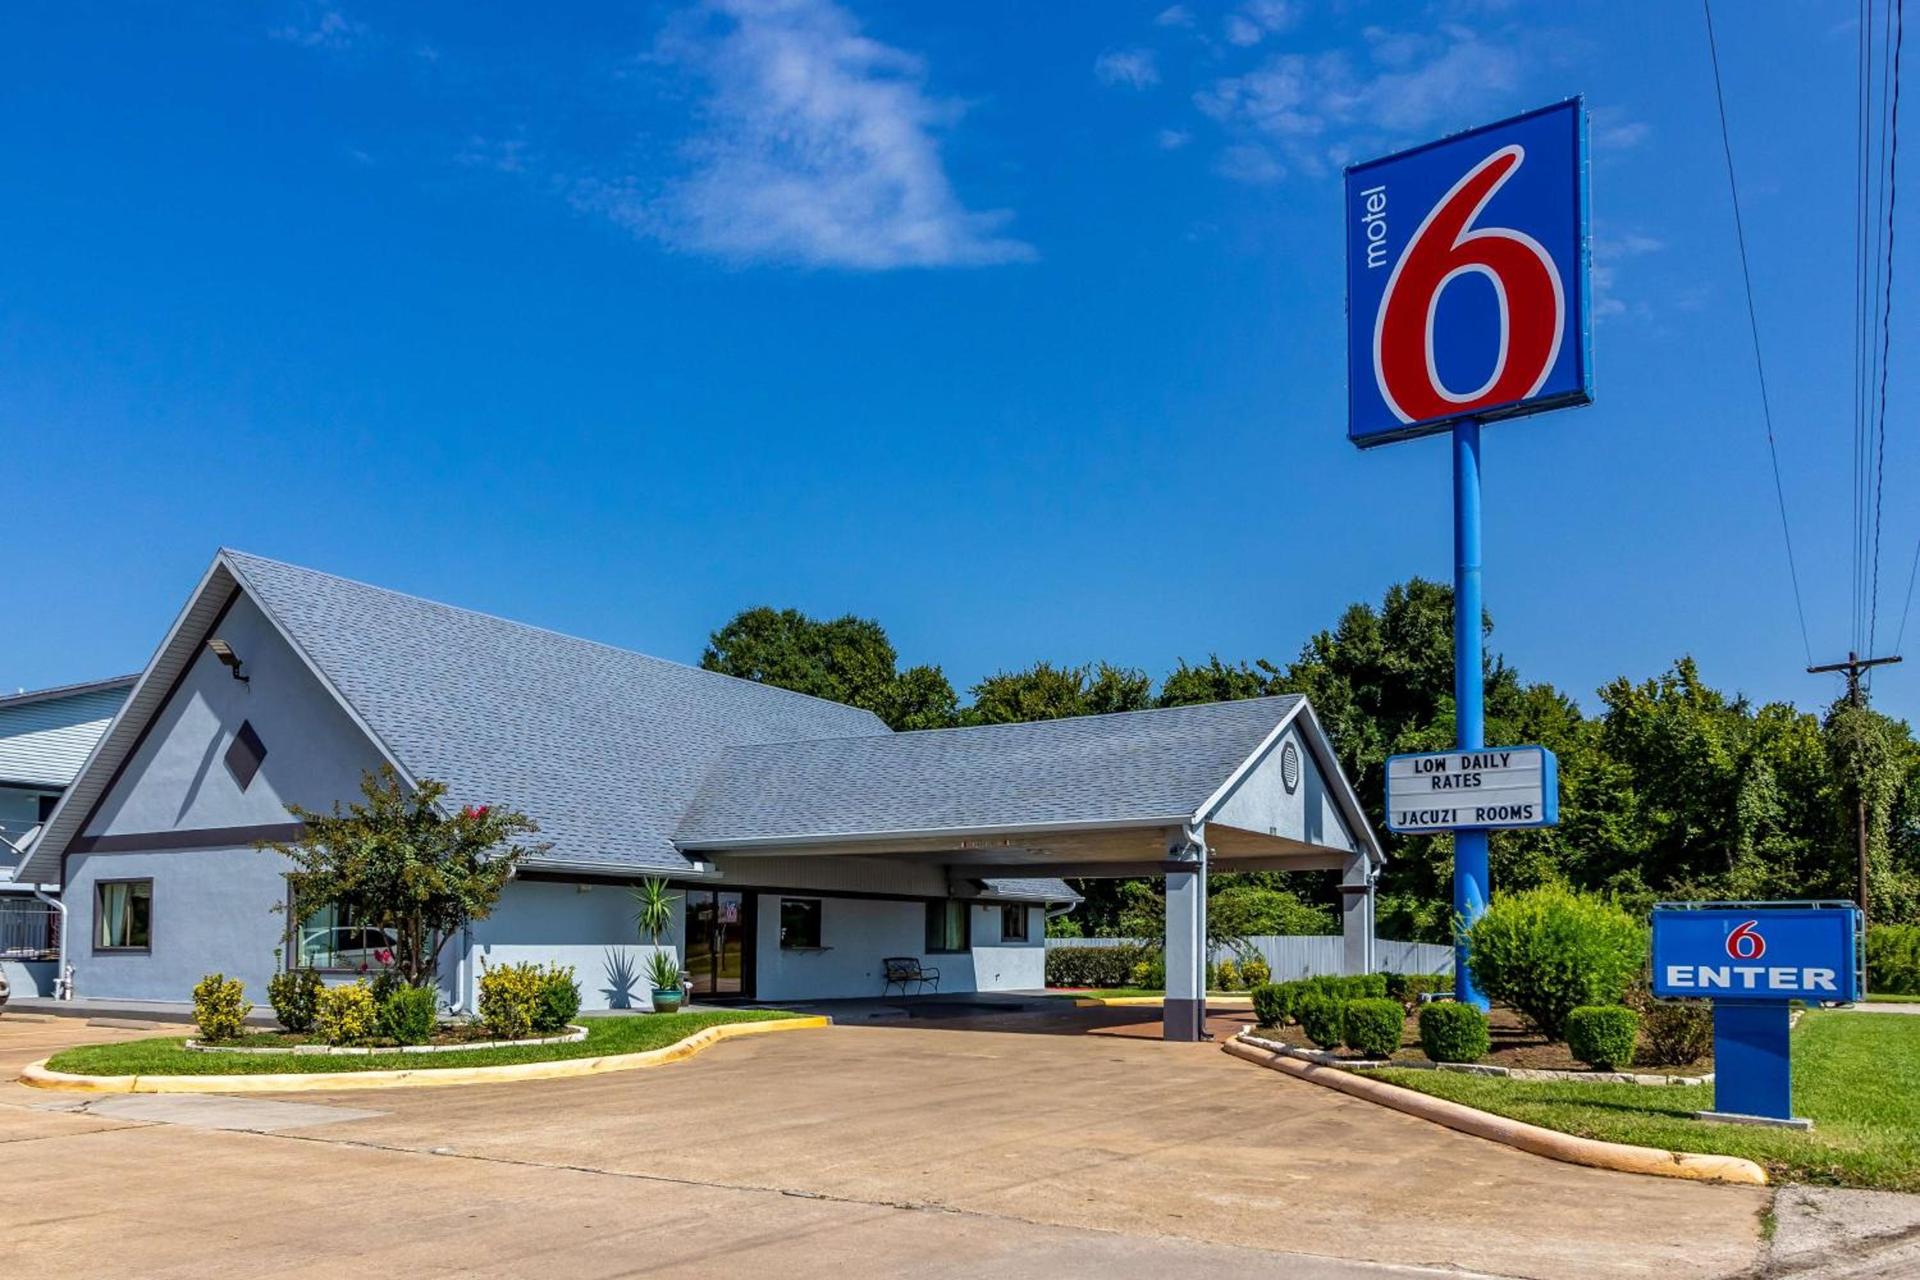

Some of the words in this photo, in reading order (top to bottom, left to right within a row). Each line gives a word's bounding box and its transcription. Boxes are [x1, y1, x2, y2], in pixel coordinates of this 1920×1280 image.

[1360, 184, 1387, 268] motel
[1373, 144, 1565, 423] 6
[1415, 758, 1446, 773] LOW
[1461, 753, 1510, 770] DAILY
[1432, 773, 1481, 789] RATES
[1398, 809, 1457, 825] JACUZI
[1476, 805, 1533, 822] ROOMS
[1725, 920, 1766, 960] 6
[1667, 965, 1838, 991] ENTER
